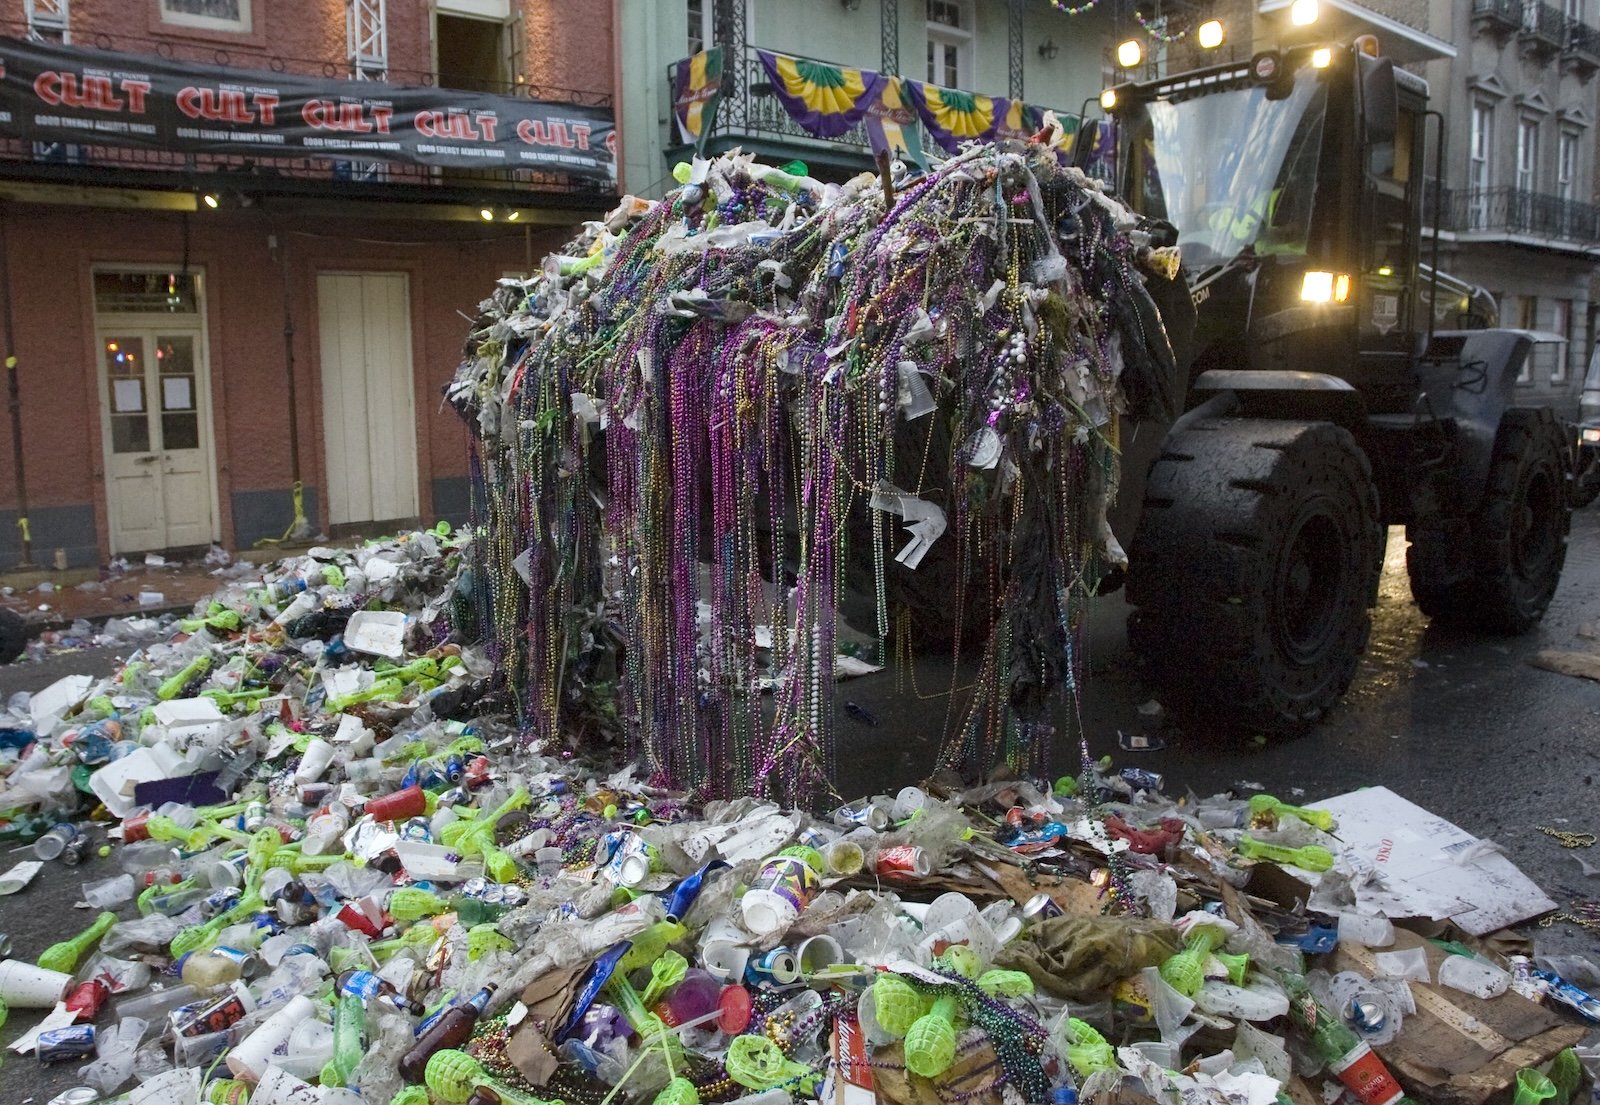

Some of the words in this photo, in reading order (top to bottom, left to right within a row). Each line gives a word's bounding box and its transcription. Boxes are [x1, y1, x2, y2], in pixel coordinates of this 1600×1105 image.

[33, 70, 151, 113] CULT
[176, 86, 279, 126] CULT
[35, 114, 60, 126] GOOD
[301, 99, 394, 134] CULT
[414, 110, 498, 142] CULT
[200, 129, 229, 140] ENERGY
[230, 131, 260, 142] ALWAYS
[516, 119, 591, 150] CULT
[837, 1011, 857, 1081] dweiser
